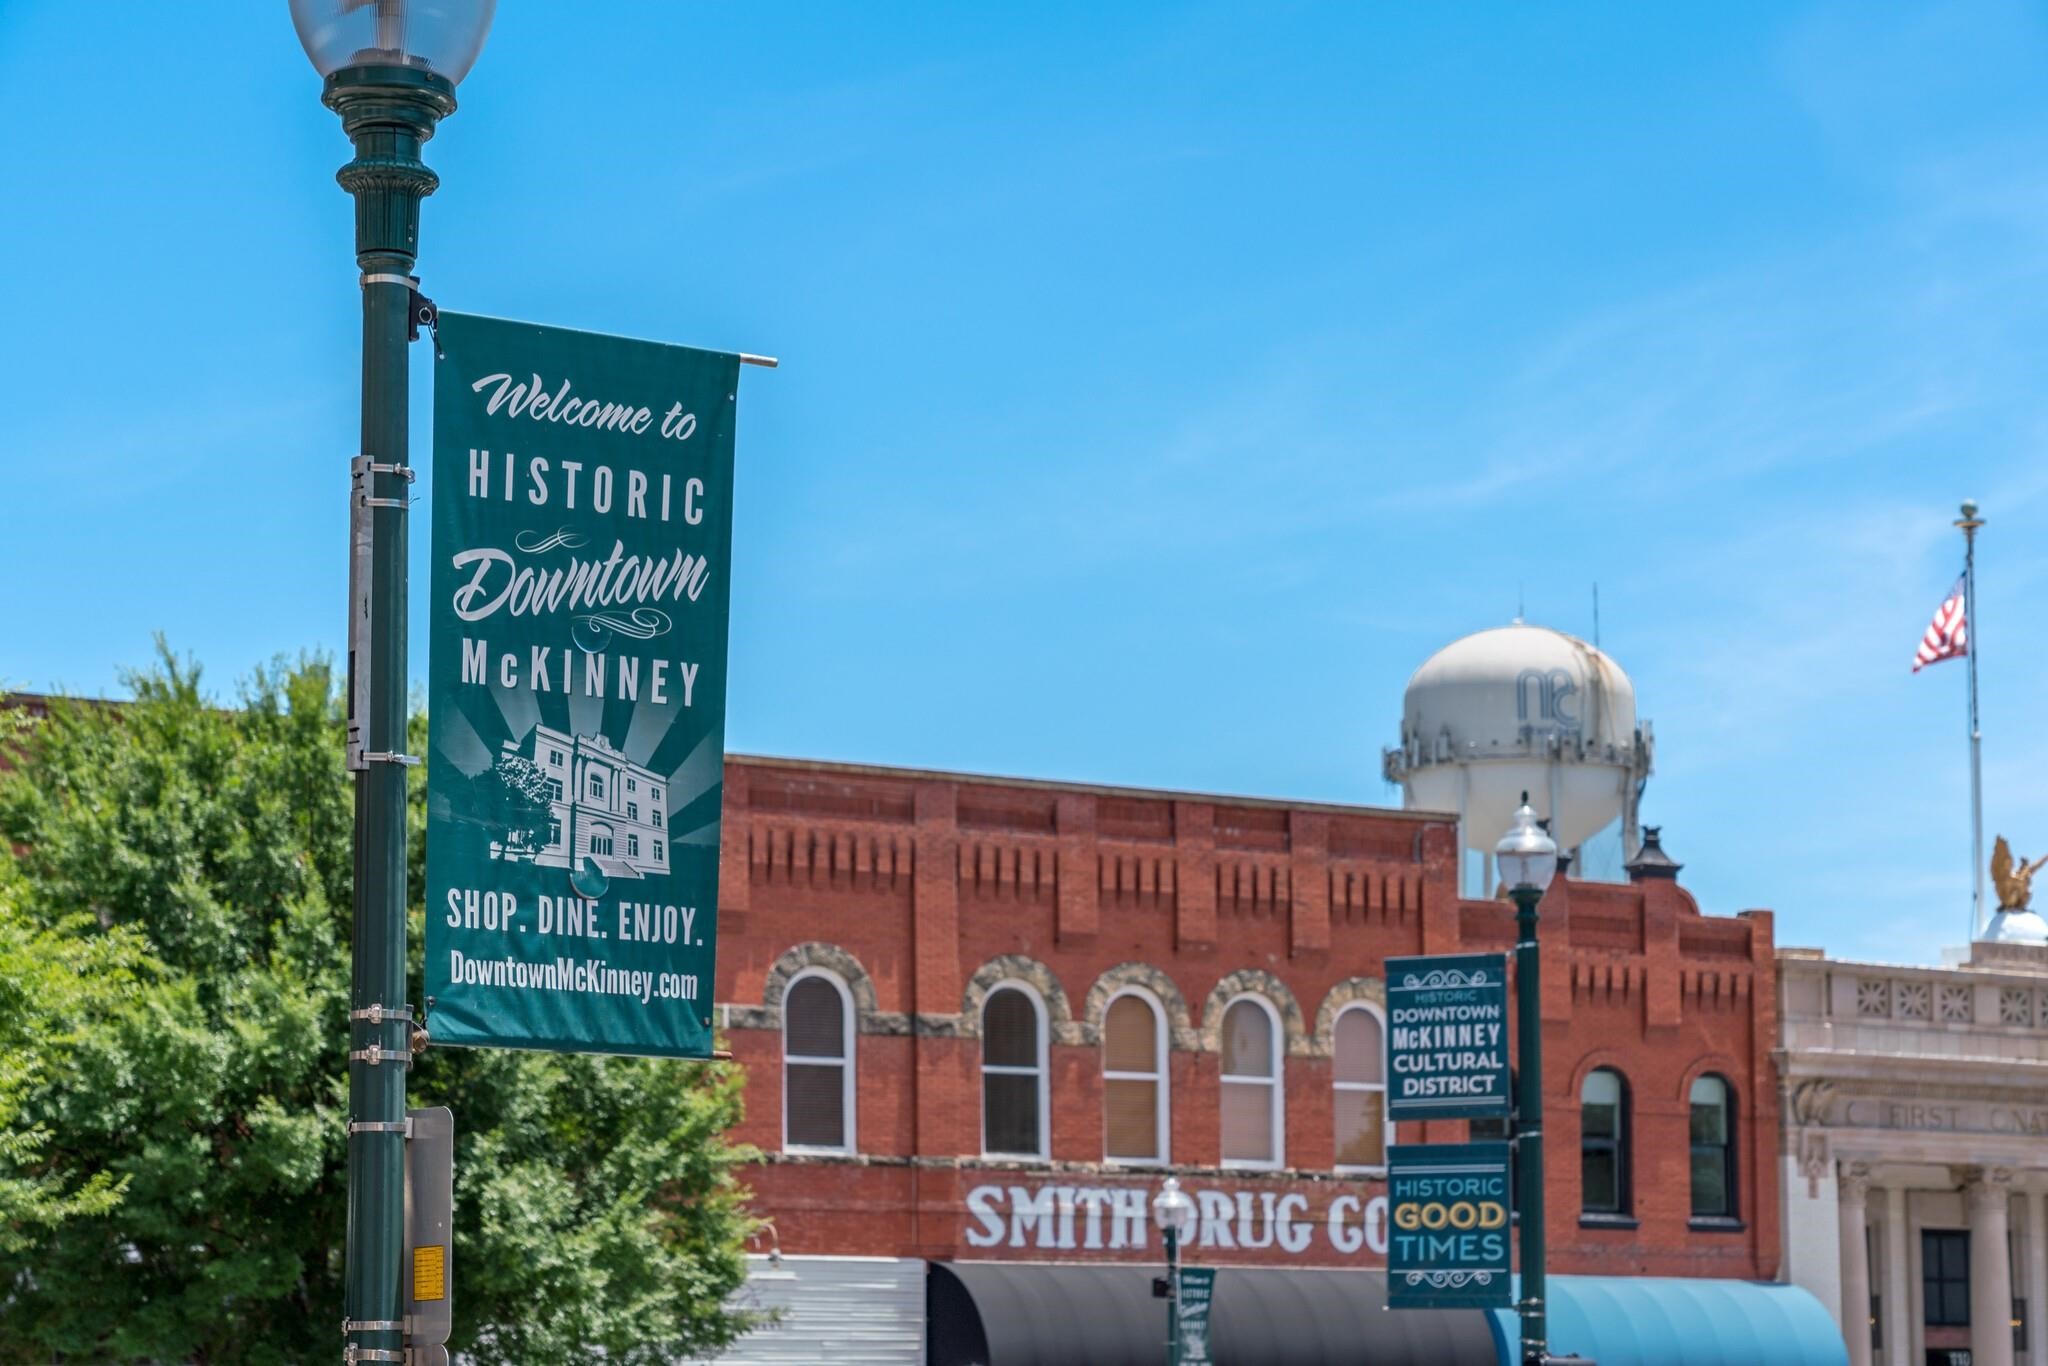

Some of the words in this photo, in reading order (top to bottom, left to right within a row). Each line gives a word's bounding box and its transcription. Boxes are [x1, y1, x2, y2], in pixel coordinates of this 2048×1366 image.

[472, 373, 653, 435] Welcome
[661, 401, 697, 440] to
[469, 449, 704, 525] HISTORIC
[453, 539, 709, 621] Downtown
[462, 637, 699, 707] McKINNEY
[447, 888, 526, 933] SHOP.
[538, 895, 607, 939] DINE.
[618, 902, 703, 946] ENJOY.
[450, 949, 698, 1004] DowntownMcKinney.com
[1414, 989, 1477, 1004] HISTORIC
[1392, 1004, 1500, 1024] DOWNTOWN
[1392, 1023, 1500, 1050] McKINNEY
[1393, 1051, 1503, 1073] CULTURAL
[1403, 1074, 1497, 1096] DISTRICT
[1888, 1103, 1961, 1130] FIRST
[1395, 1178, 1503, 1197] HISTORIC
[965, 1184, 1148, 1250] SMITH
[1394, 1201, 1507, 1230] GOOD
[1395, 1233, 1504, 1262] TIMES
